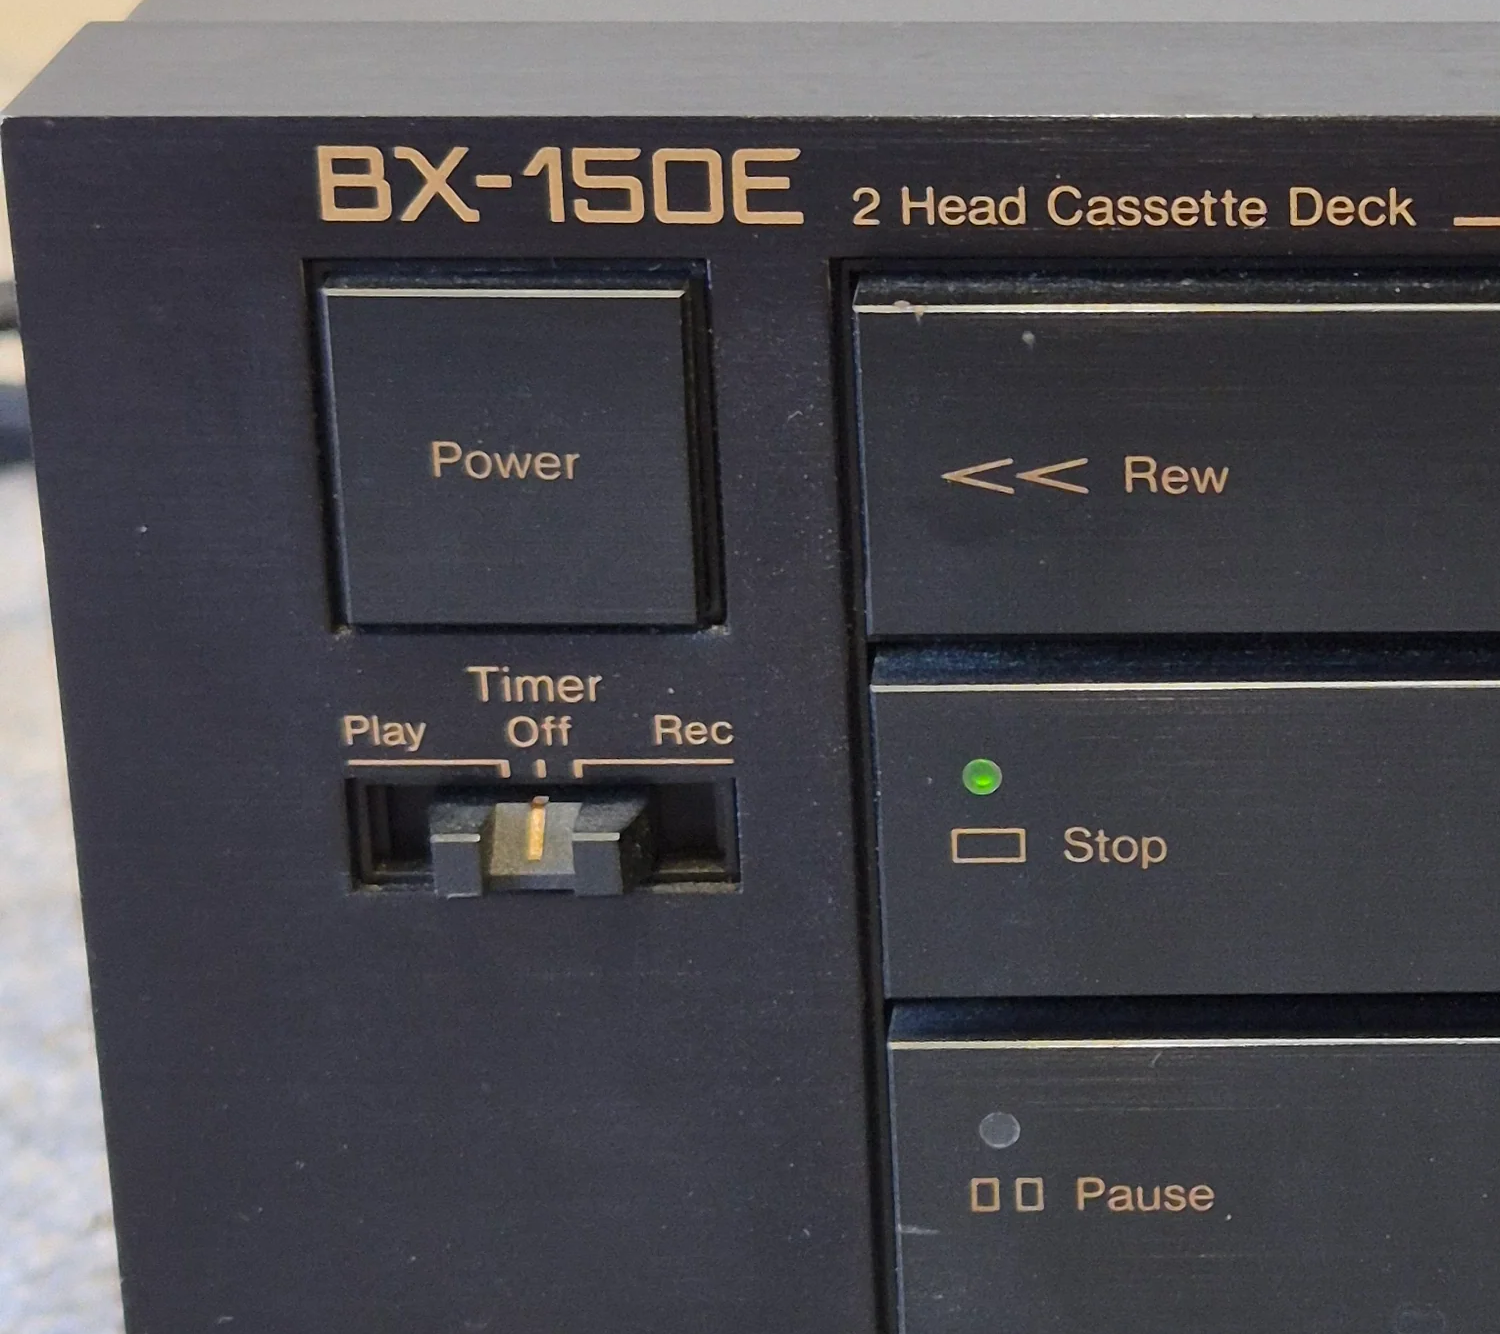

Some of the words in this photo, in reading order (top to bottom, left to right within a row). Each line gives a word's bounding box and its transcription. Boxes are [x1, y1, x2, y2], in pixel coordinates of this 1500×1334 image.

[315, 145, 804, 225] BX-150E
[852, 187, 881, 225] 2
[902, 186, 1027, 227] Head
[1046, 186, 1267, 228] Cassette
[1289, 187, 1417, 228] Deck
[431, 440, 580, 480] Power
[1124, 456, 1229, 495] Rew
[467, 665, 602, 703] Timer
[343, 714, 426, 750] Play
[506, 715, 573, 748] Off
[654, 714, 734, 746] Rec
[1063, 827, 1168, 869] Stop
[1075, 1176, 1214, 1213] Pause
